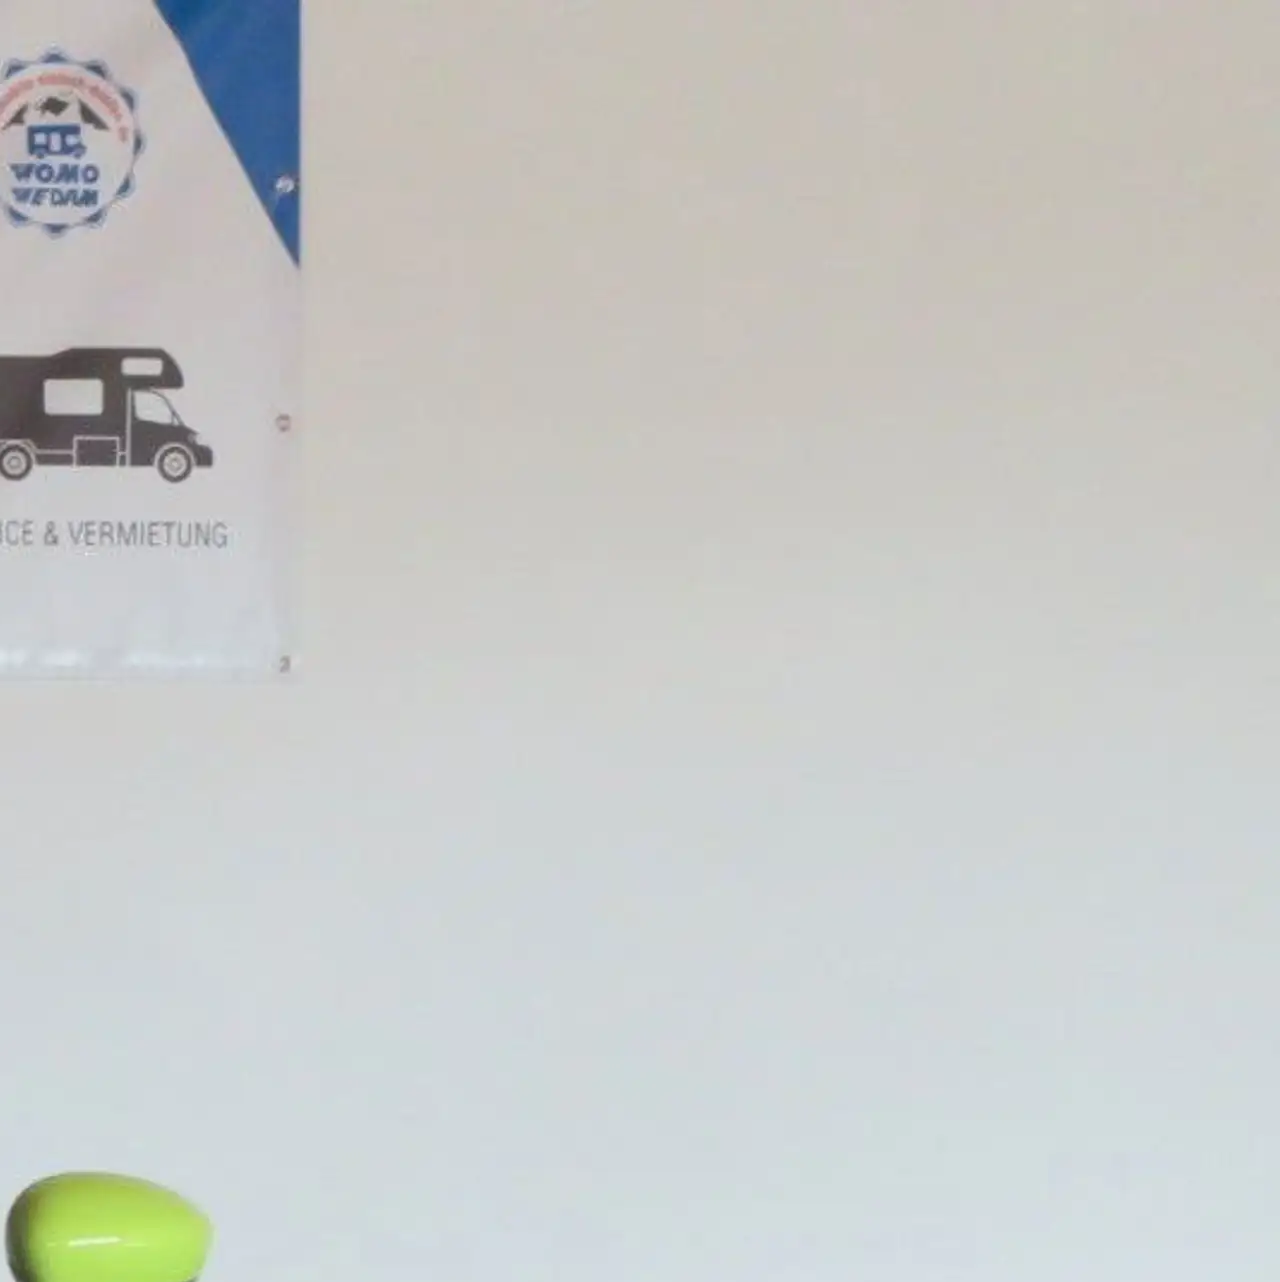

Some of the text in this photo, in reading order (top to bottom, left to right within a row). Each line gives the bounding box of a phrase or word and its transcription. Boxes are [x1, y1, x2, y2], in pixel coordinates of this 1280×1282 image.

[10, 162, 100, 183] WOMO
[11, 186, 99, 207] WEDAM
[42, 519, 61, 548] &
[68, 520, 229, 550] VERMIETUNG
